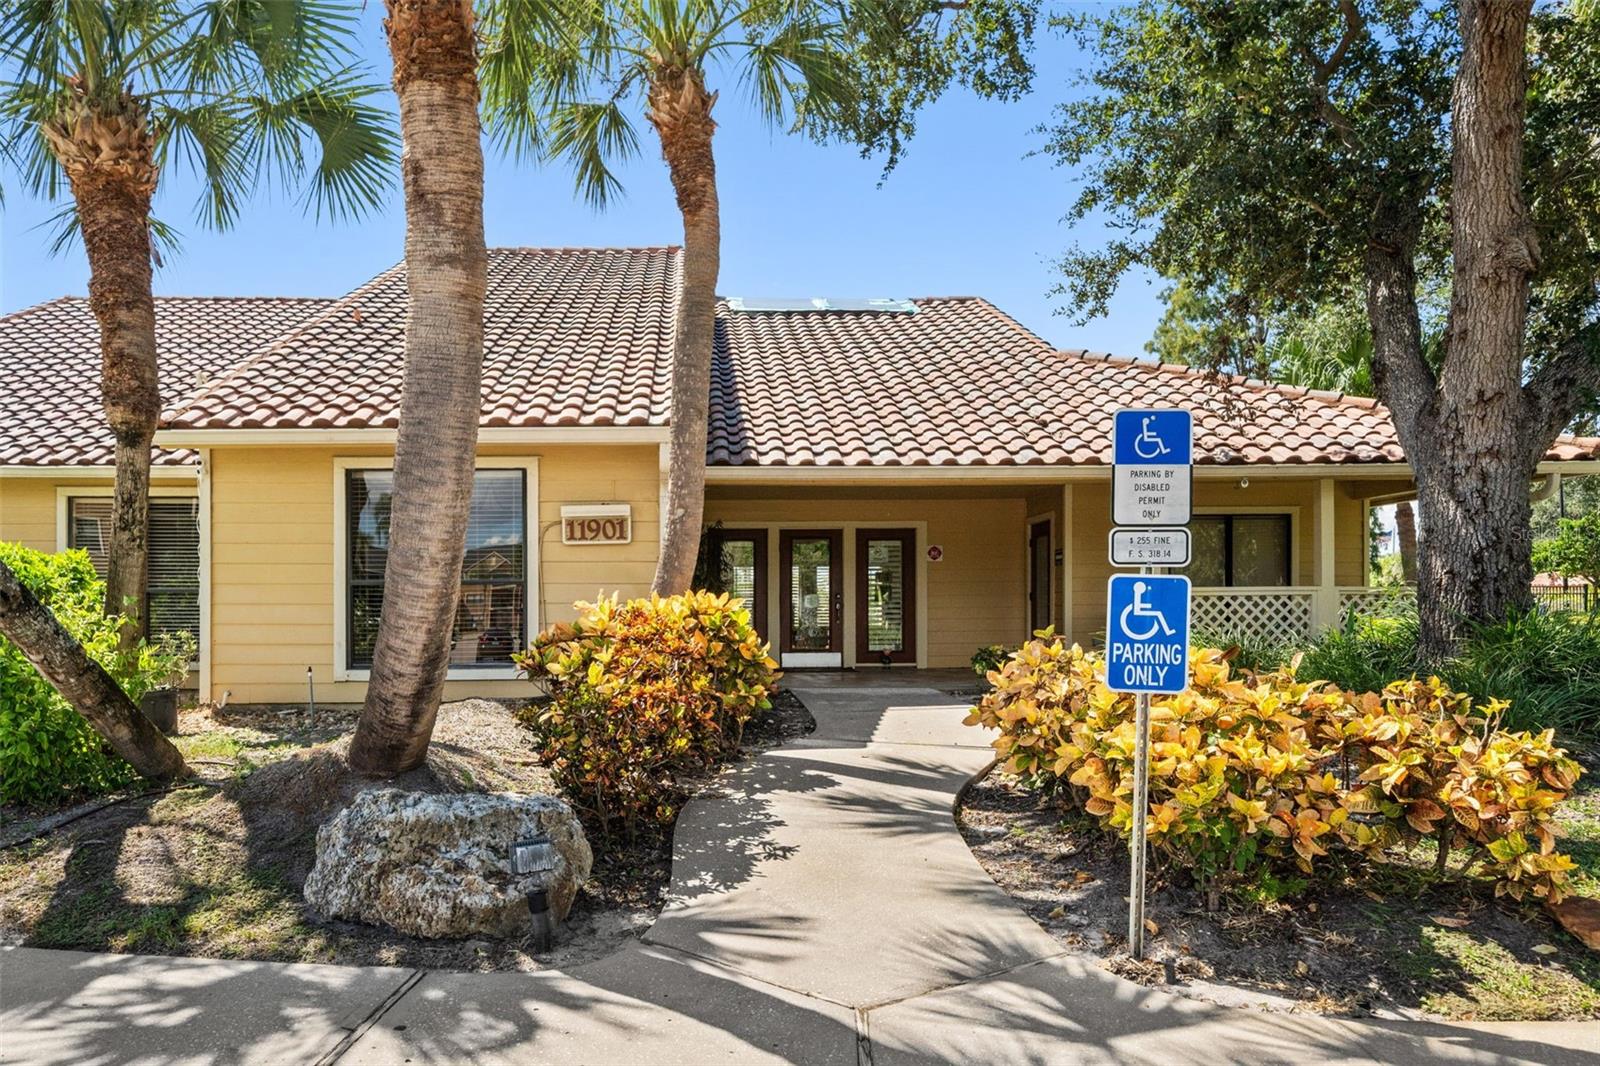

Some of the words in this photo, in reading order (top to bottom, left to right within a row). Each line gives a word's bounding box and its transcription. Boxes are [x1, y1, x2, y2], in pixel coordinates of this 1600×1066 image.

[1130, 470, 1161, 478] PARKING
[1164, 470, 1175, 478] BY
[1134, 483, 1170, 491] DISABLED
[1138, 496, 1165, 504] PERMIT
[1142, 510, 1161, 518] ONLY
[566, 519, 627, 541] 11901
[1136, 536, 1151, 545] 255
[1153, 536, 1171, 545] FINE
[1112, 642, 1182, 665] PARKING
[1123, 664, 1169, 687] ONLY
